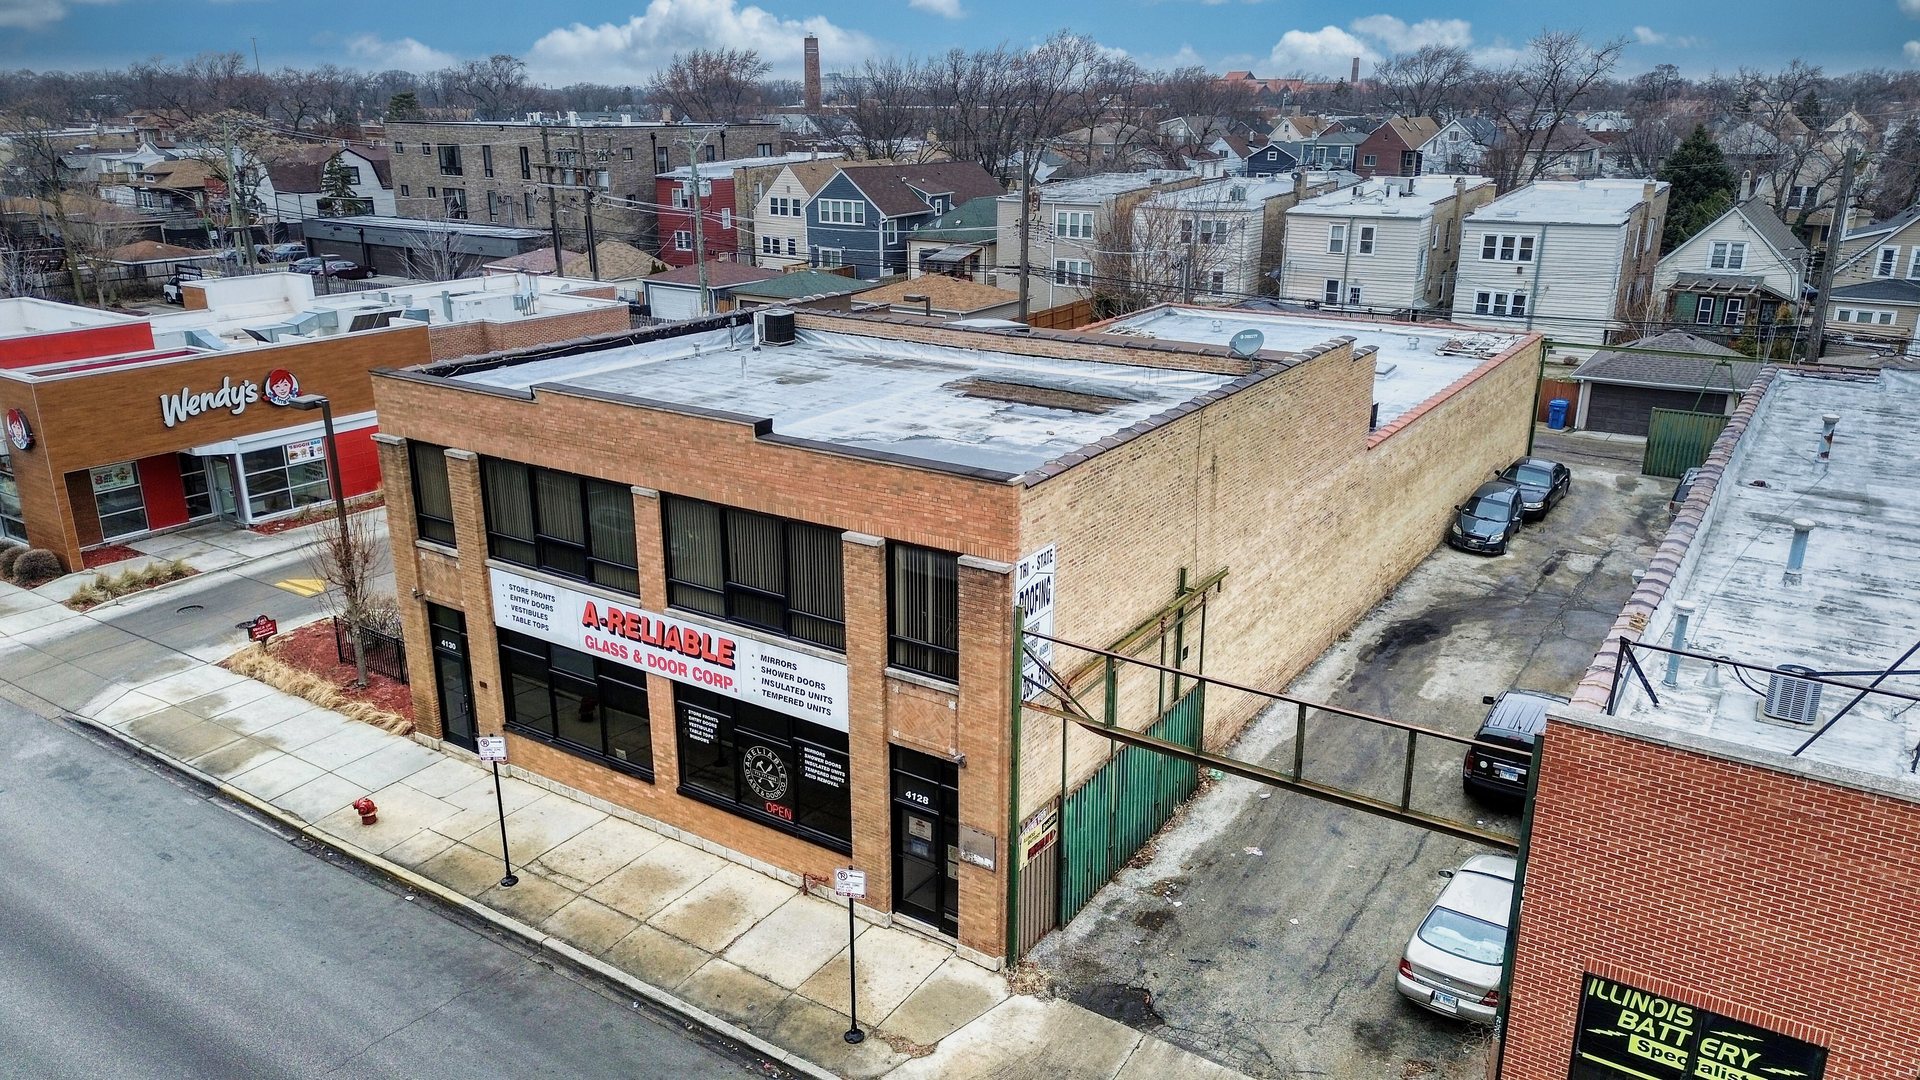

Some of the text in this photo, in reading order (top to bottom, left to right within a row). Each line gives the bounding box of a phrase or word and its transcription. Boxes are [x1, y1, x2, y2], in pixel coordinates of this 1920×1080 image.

[160, 376, 259, 428] Wendy's
[1019, 561, 1029, 580] TRI
[1036, 548, 1053, 571] STATE
[508, 583, 556, 603] STORE FRONTS
[510, 593, 554, 612] ENTRY DOORS
[510, 603, 549, 621] VESTIBULES
[511, 614, 549, 631] TABLE TOPS
[441, 639, 457, 650] 4130
[582, 600, 737, 671] A-RELIABLE
[584, 634, 738, 693] GLASS & DOOR CORP.
[760, 654, 798, 671] MIRRORS
[760, 665, 826, 691] SHOWER DOORS
[761, 677, 833, 705] INSULATED UNITS
[761, 688, 832, 716] TEMPERED UNITS
[905, 790, 929, 805] 4128
[766, 802, 792, 820] OPEN
[1588, 977, 1694, 1027] ILLINOIS
